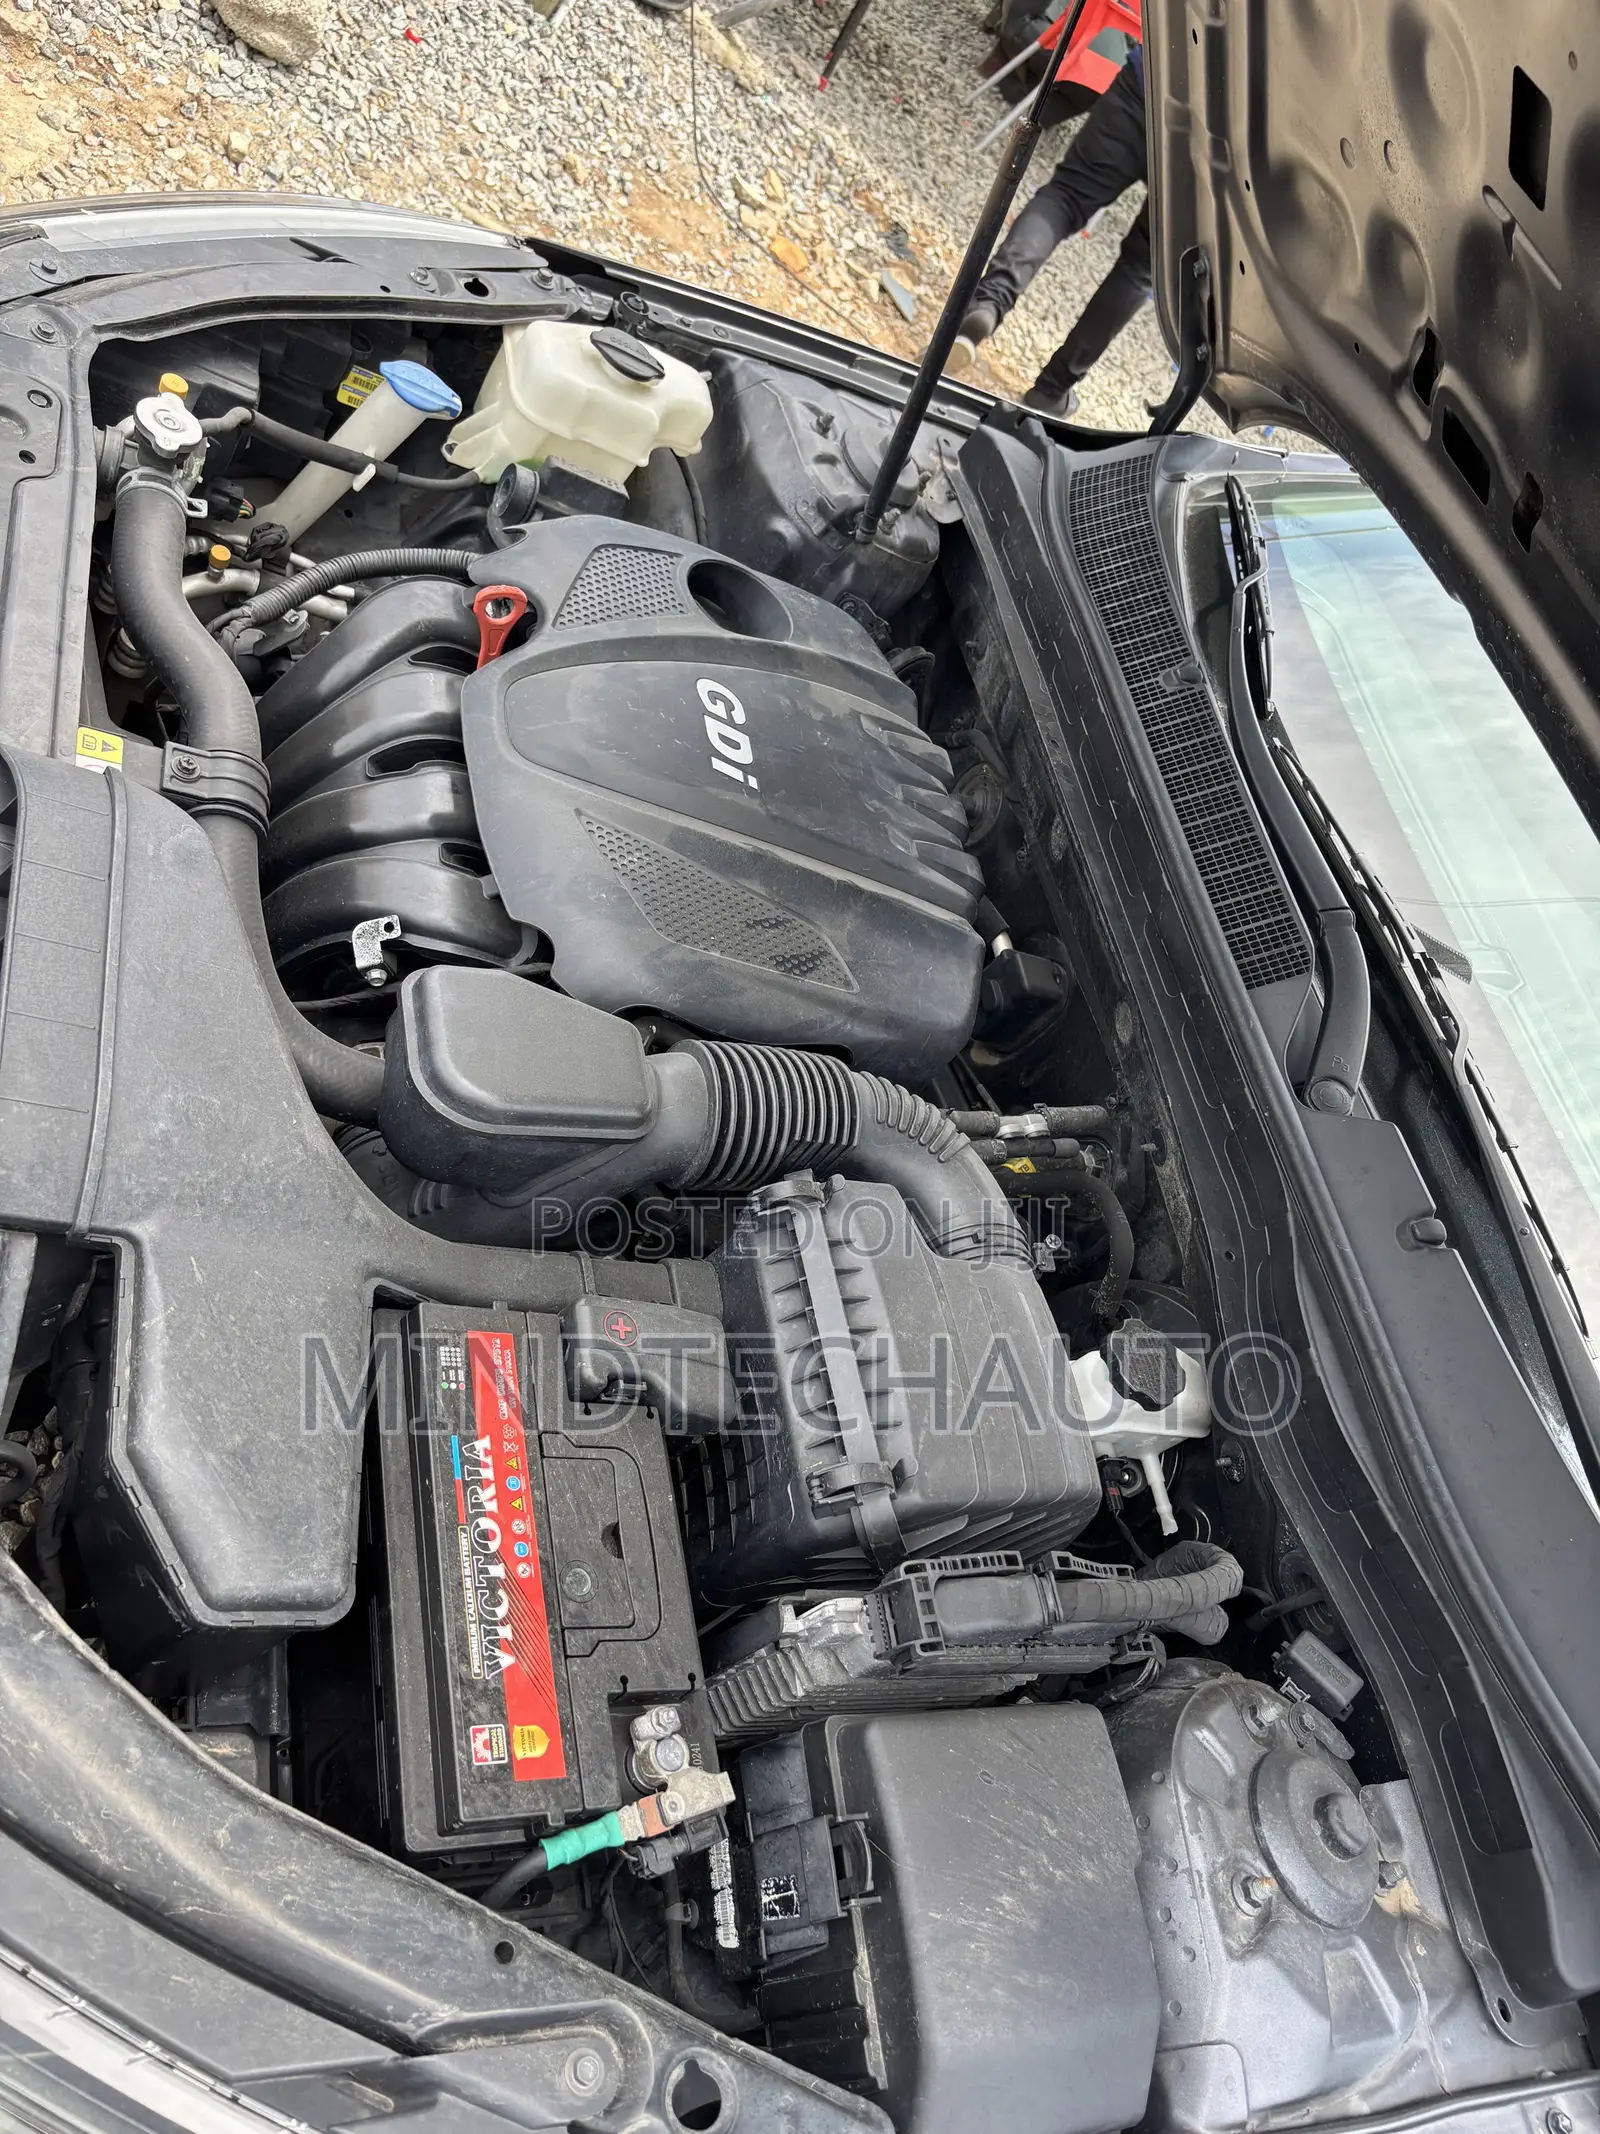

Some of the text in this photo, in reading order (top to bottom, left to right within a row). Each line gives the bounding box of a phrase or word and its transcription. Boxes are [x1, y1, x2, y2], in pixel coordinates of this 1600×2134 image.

[1018, 1163, 1030, 1174] TB
[461, 1434, 516, 1680] VICTORIA
[460, 1531, 480, 1674] PREMIUM CALCIUM BATTERY
[490, 1727, 499, 1759] TROPICAL
[497, 1727, 505, 1759] STANDARD
